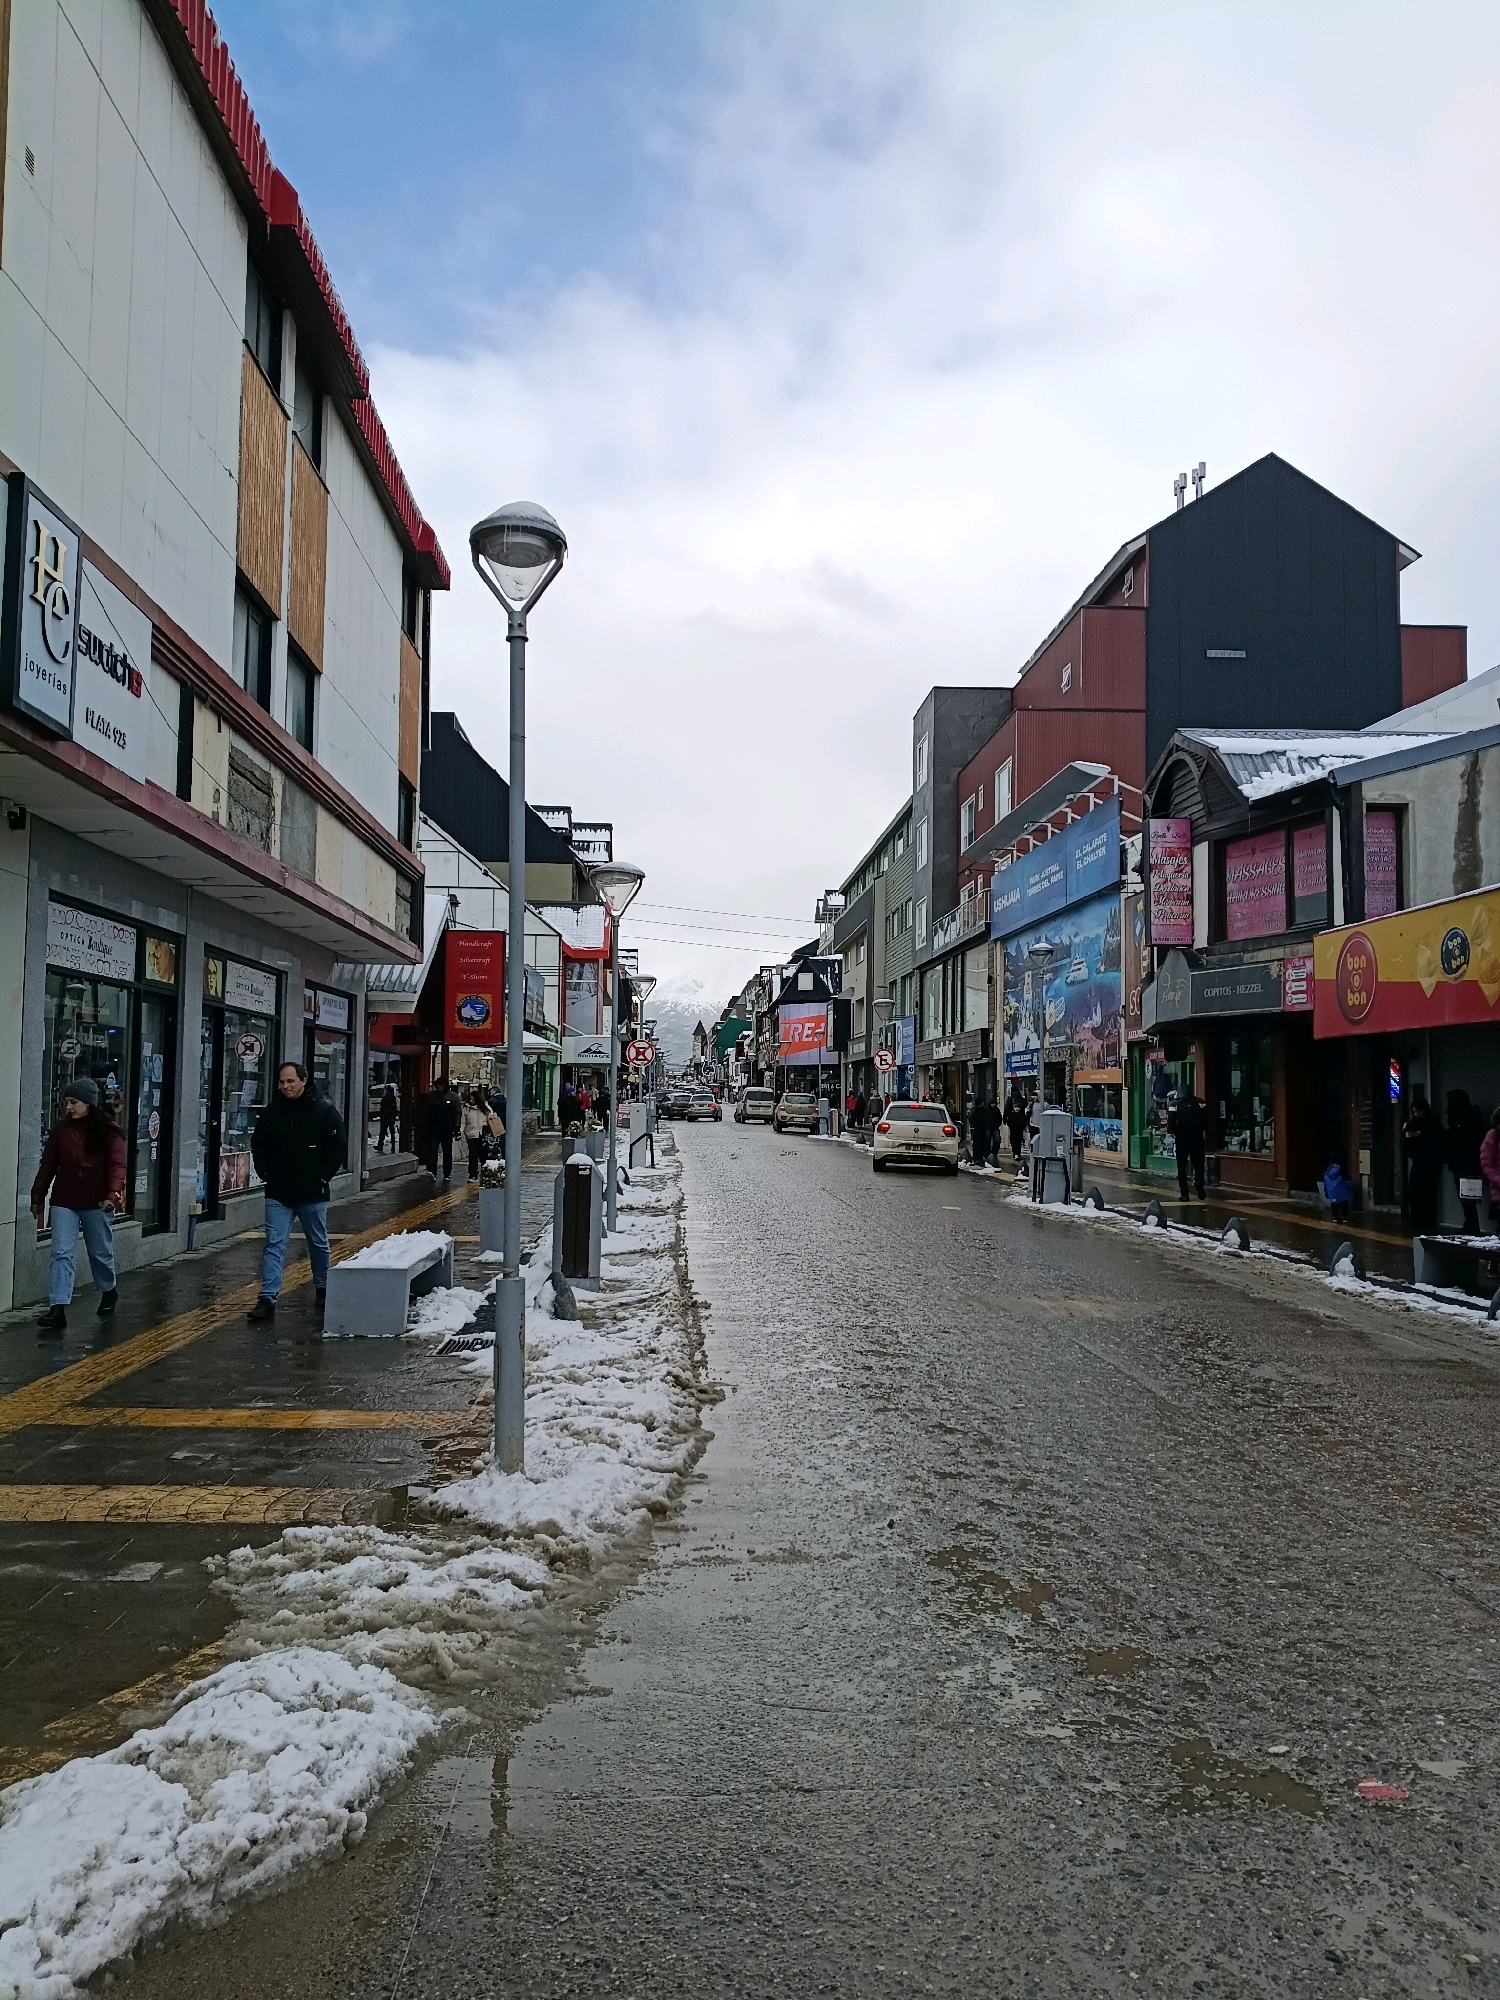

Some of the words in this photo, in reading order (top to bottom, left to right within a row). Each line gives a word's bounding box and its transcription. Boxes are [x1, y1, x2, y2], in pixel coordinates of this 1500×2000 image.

[77, 623, 132, 691] swatch
[85, 706, 111, 739] PLATA
[112, 726, 127, 749] 925
[1082, 832, 1108, 854] CALAFATE
[1152, 854, 1188, 868] Masajes
[1226, 855, 1286, 884] MASSAGES
[994, 888, 1021, 913] USHUAIA
[457, 940, 493, 950] Handicraft
[459, 957, 492, 966] Silvercraft
[1346, 953, 1367, 971] bon
[1204, 986, 1232, 998] COPITOS
[1236, 984, 1264, 995] HEZZEL
[1347, 988, 1367, 1006] bon
